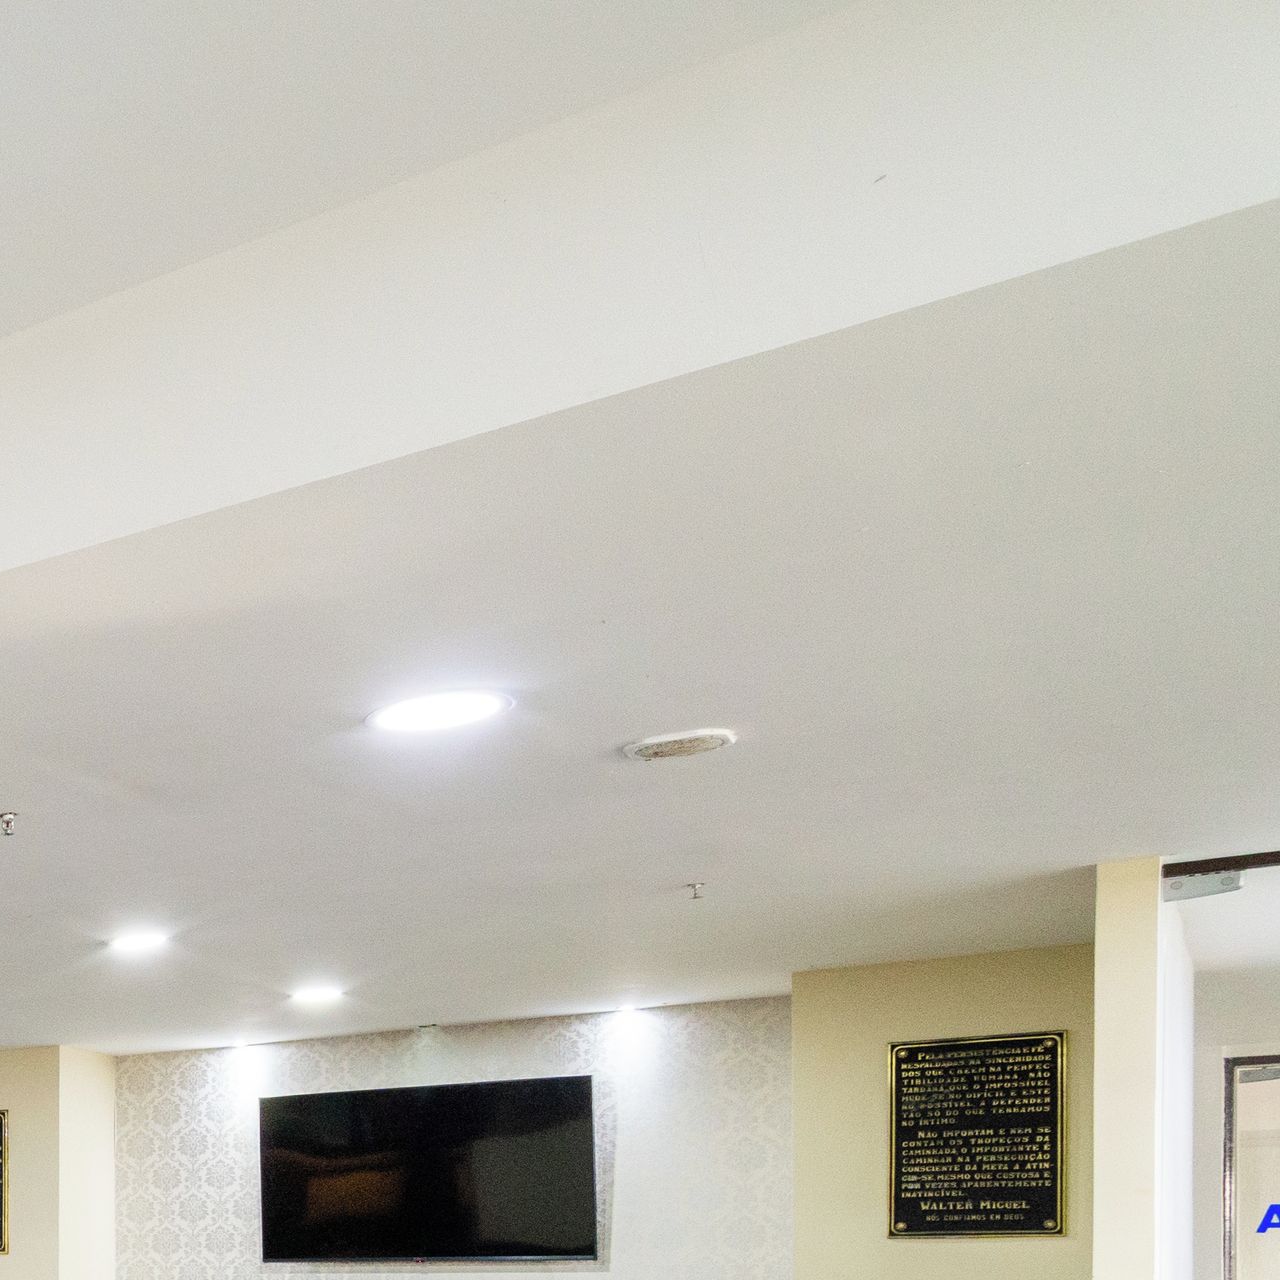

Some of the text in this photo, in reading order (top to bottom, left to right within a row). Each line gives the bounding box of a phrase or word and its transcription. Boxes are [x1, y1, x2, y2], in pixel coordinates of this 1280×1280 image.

[985, 1054, 1052, 1065] SINCERIDADE
[925, 1069, 944, 1077] QUE
[1022, 1087, 1051, 1096] ESTE
[992, 1096, 1051, 1106] DEPENDER
[945, 1109, 960, 1117] DO
[964, 1107, 985, 1116] QUE
[991, 1105, 1051, 1115] TENHAMOS
[901, 1119, 915, 1127] NO
[943, 1129, 994, 1138] IMPORTAM
[1037, 1126, 1052, 1134] SE
[901, 1135, 1051, 1148] CONTAM OS TROPEÇOS DA
[960, 1146, 968, 1154] O
[971, 1144, 1040, 1154] IMPORTANTE
[902, 1151, 1051, 1165] CAMINHAR NA PERSEGUIÇÃO
[901, 1164, 961, 1173] CONSCIENTE
[982, 1163, 1009, 1171] META
[937, 1173, 971, 1181] MESMO
[995, 1171, 1040, 1180] CUSTOSA
[960, 1179, 1052, 1189] APARENTEMENTE
[920, 1200, 1031, 1211] WALTER MIGUEL
[943, 1213, 987, 1222] CONFIAMOS
[990, 1213, 1001, 1221] EM
[1004, 1213, 1025, 1221] DEUS
